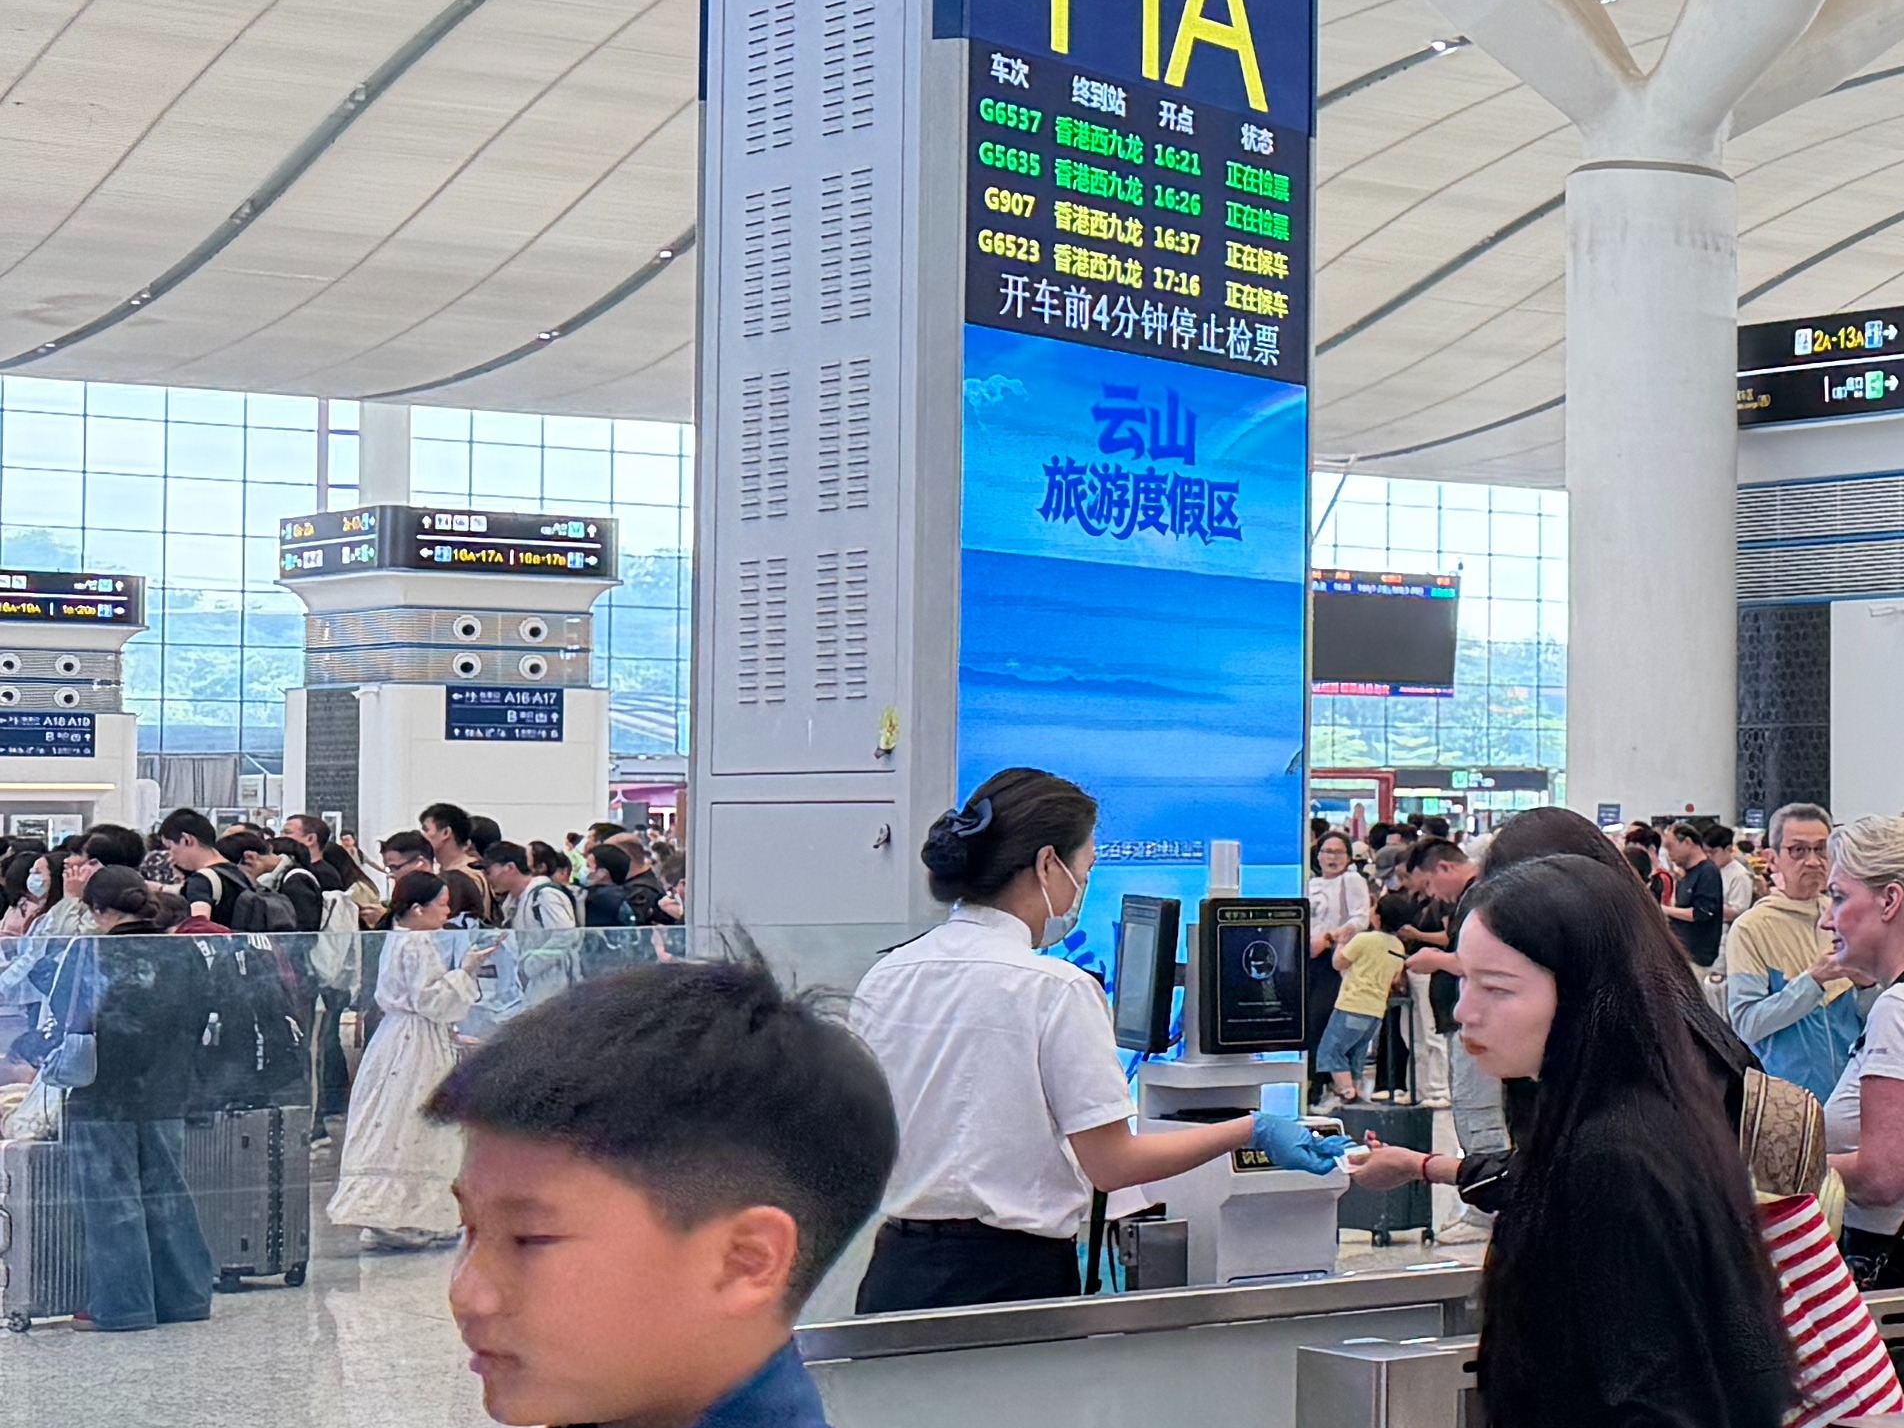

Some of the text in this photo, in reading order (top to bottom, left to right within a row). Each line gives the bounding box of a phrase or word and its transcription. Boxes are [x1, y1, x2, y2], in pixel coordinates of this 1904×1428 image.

[979, 97, 1291, 203] G6537 香港西九龙 16:21 正在检票
[990, 52, 1274, 155] 车次 终到站 开点 状态
[979, 141, 1291, 242] G5635 香港西九龙 16:26 正在检票
[984, 187, 1290, 280] G907 香港西九龙 16:37 正在候车
[978, 229, 1290, 319] G6523 香港西九龙 17:16 正在候车
[1000, 273, 1280, 366] 开车前4分钟停止检票
[1813, 326, 1864, 352] 2A-13A
[1091, 383, 1197, 467] 云山
[1037, 454, 1244, 545] 旅游度假区
